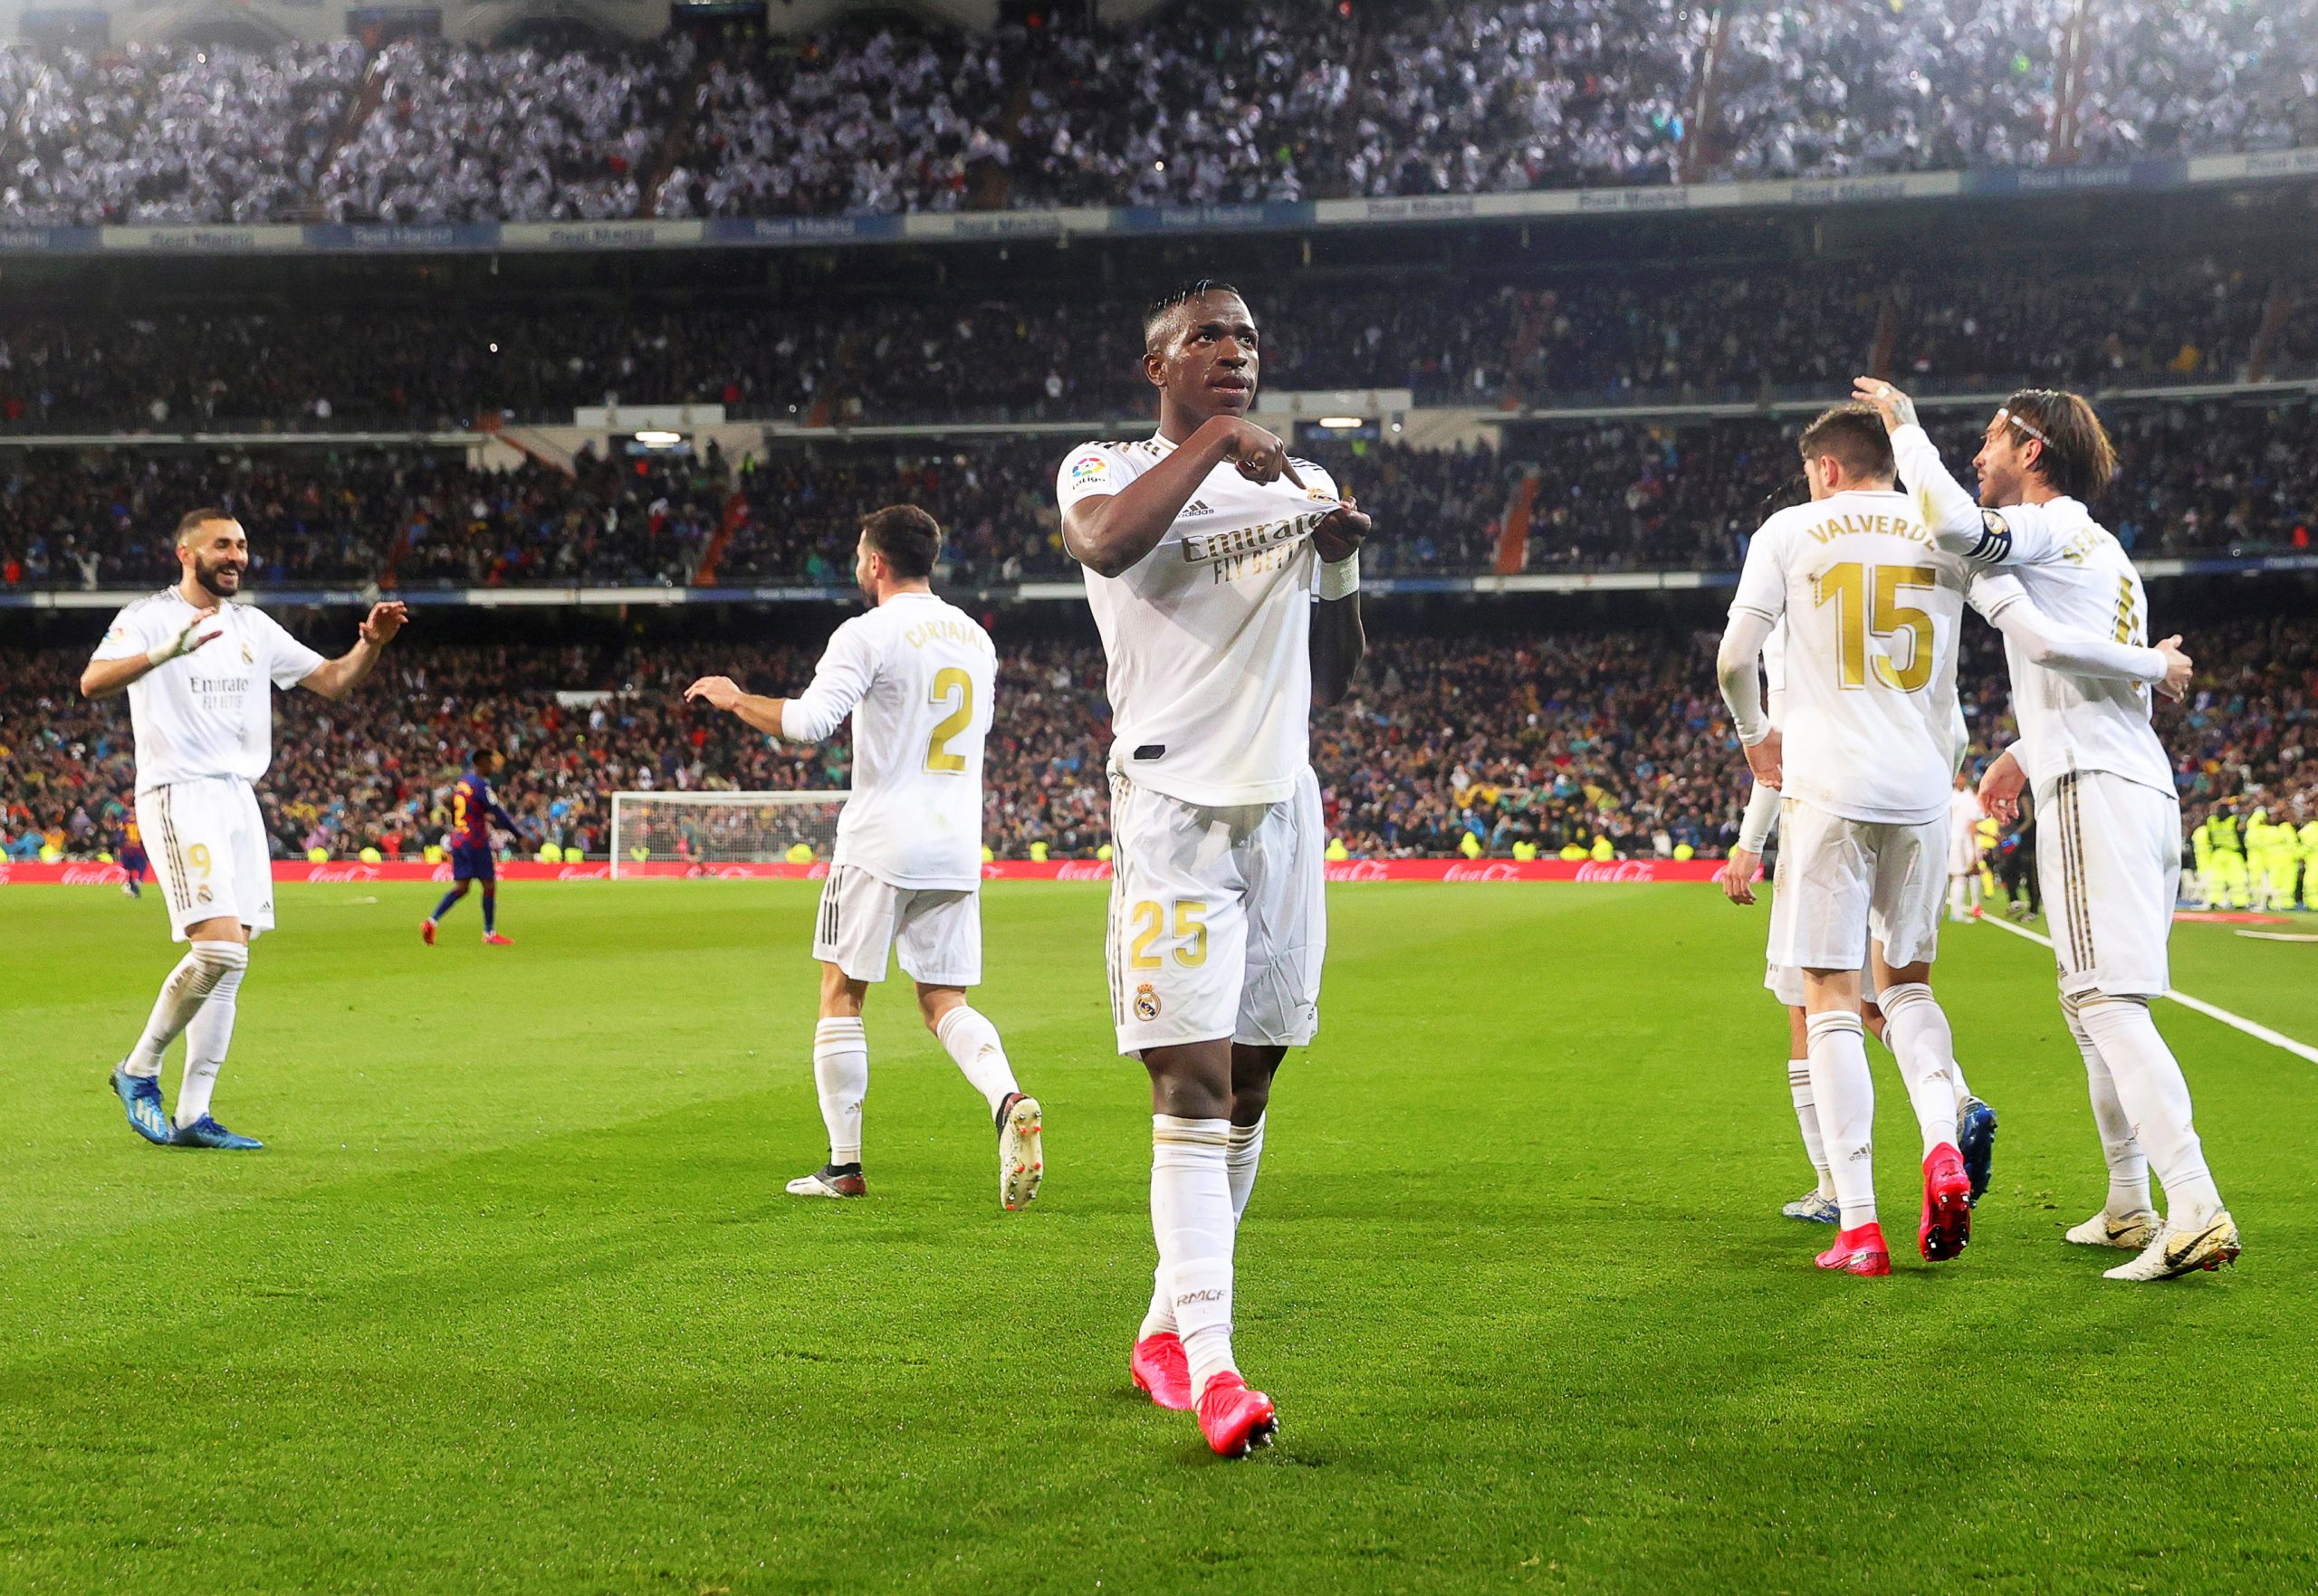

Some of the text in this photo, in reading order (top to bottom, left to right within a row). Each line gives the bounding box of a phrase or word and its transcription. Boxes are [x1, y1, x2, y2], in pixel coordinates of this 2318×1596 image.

[1181, 510, 1327, 563] Emirate
[1213, 553, 1245, 586] FLY
[905, 620, 985, 653] CARVAJAL
[1815, 562, 1937, 693] 15
[922, 666, 973, 776] 2
[187, 843, 212, 878] 9
[1128, 899, 1208, 971] 25
[1176, 1288, 1228, 1307] RMCF
